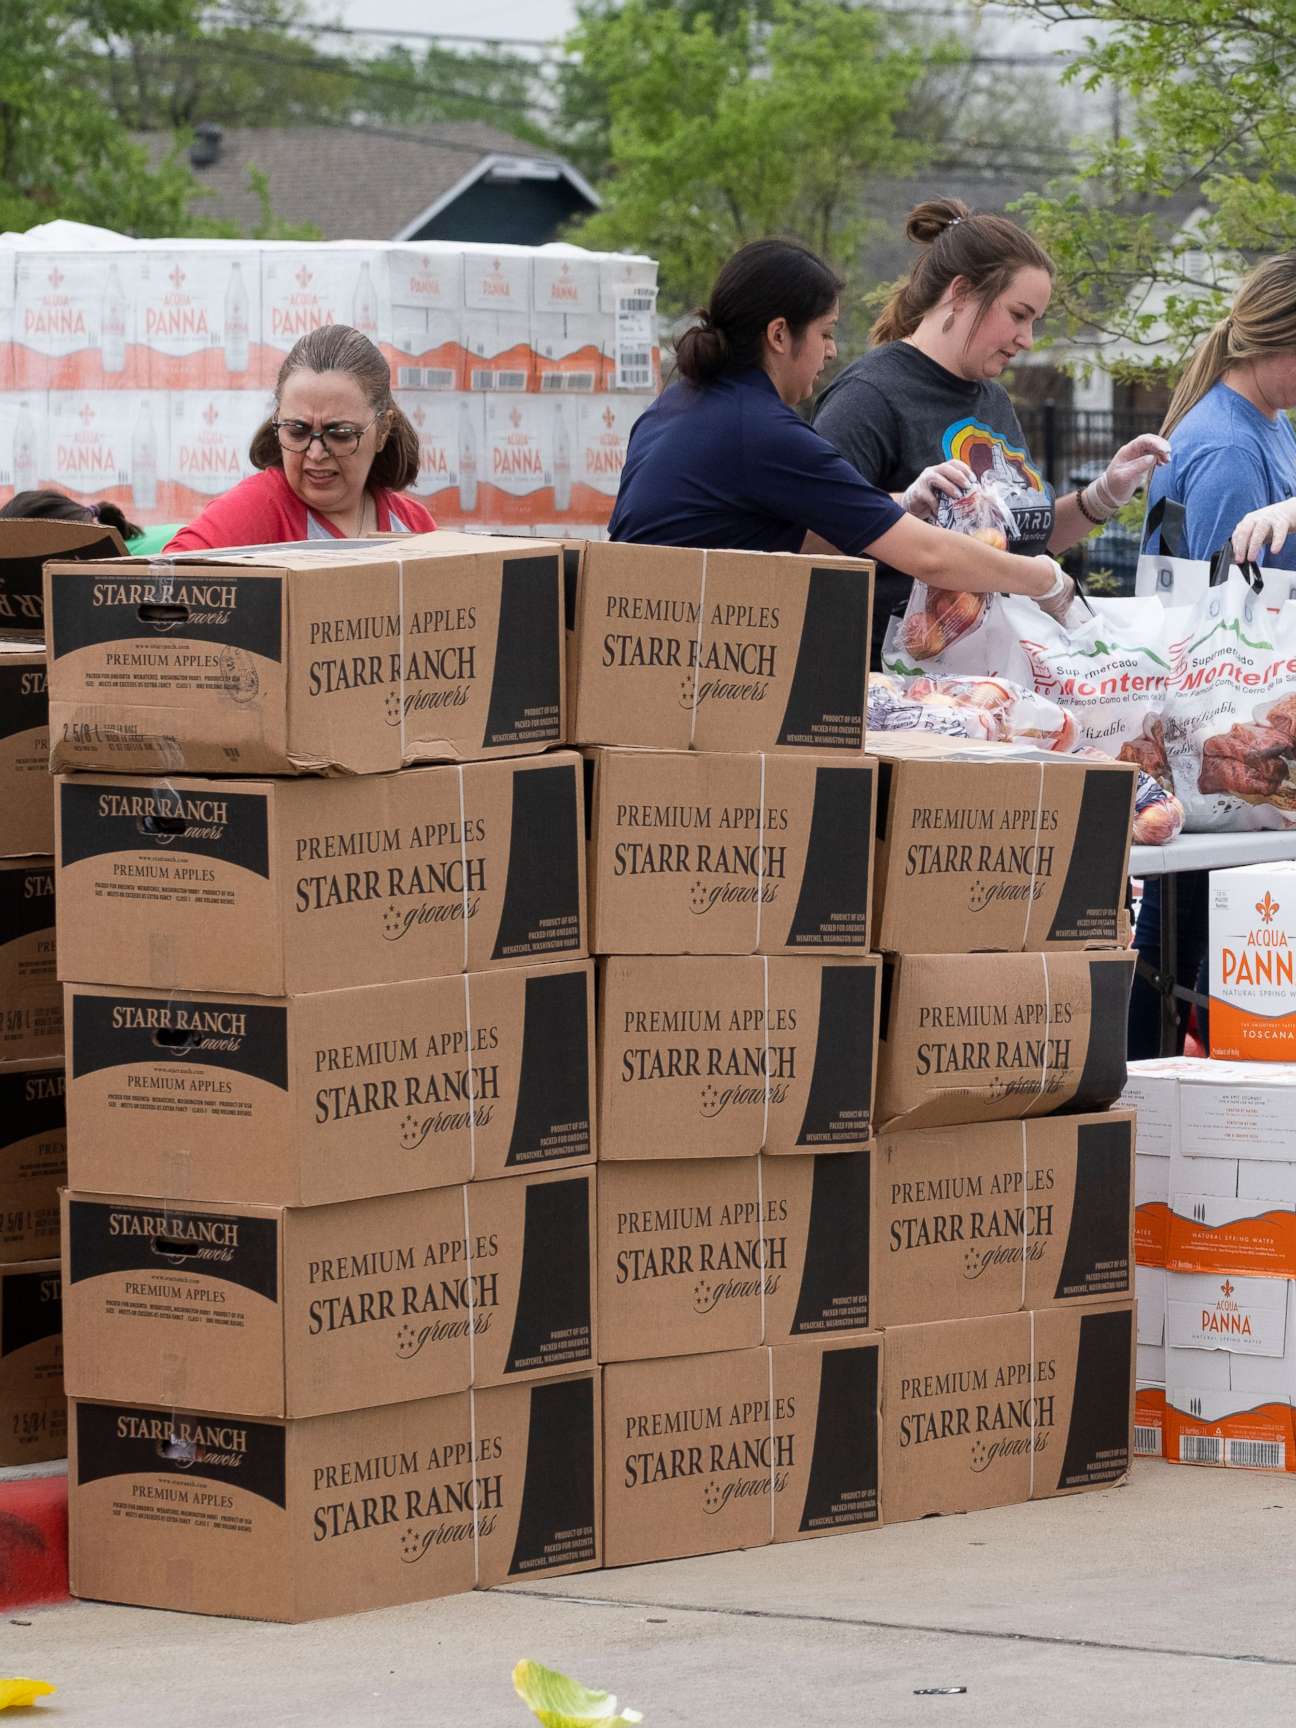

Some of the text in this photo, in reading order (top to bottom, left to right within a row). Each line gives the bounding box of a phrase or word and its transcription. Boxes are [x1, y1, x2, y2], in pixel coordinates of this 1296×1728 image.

[24, 308, 86, 334] PANNA
[145, 308, 208, 335] PANNA
[57, 448, 116, 472] PANNA
[179, 448, 240, 473] PANNA
[494, 448, 543, 473] PANNA
[586, 448, 625, 474] PANN
[93, 584, 238, 609] STARR RANCH
[606, 596, 780, 629] PREMIUM APPLES
[310, 607, 476, 644] PREMIUM APPLES
[106, 654, 219, 667] PREMIUM APPLES
[309, 646, 476, 696] STARR RANCH
[602, 634, 776, 677] STARR RANCH
[1057, 659, 1138, 679] Suprmercado
[21, 673, 48, 695] STA
[694, 679, 768, 705] growers
[1061, 672, 1170, 696] Monterr
[1242, 686, 1265, 694] Cerro
[1275, 677, 1282, 685] la
[395, 685, 470, 720] growers
[1057, 697, 1068, 705] Tan
[99, 794, 228, 824] STARR RANCH
[616, 804, 788, 830] PREMIUM APPLES
[911, 808, 1059, 831] PREMIUM APPLES
[296, 818, 486, 861] PREMIUM APPLES
[113, 863, 216, 881] PREMIUM APPLES
[614, 842, 787, 879] STARR RANCH
[905, 844, 1055, 877] STARR RANCH
[24, 876, 55, 898] STA
[296, 858, 488, 913] STARR RANCH
[701, 881, 780, 910] growers
[977, 881, 1046, 907] growers
[399, 896, 480, 935] growers
[1247, 929, 1288, 948] ACQUA
[1222, 989, 1256, 998] NATURAL
[1259, 990, 1287, 998] SPRING
[112, 1006, 247, 1036] STARR RANCH
[624, 1008, 797, 1032] PREMIUM APPLES
[919, 1002, 1073, 1028] PREMIUM APPLES
[315, 1026, 499, 1072] PREMIUM APPLES
[1242, 1031, 1295, 1040] TOSCANA
[622, 1046, 797, 1082] STARR RANCH
[916, 1039, 1072, 1076] STARR RANCH
[25, 1076, 66, 1101] STAR
[127, 1075, 232, 1093] PREMIUM APPLES
[316, 1065, 500, 1124] STARR RANCH
[711, 1083, 788, 1112] growers
[414, 1104, 494, 1142] growers
[891, 1168, 1055, 1205] PREMIUM APPLES
[109, 1213, 239, 1247] STARR RANCH
[617, 1199, 788, 1235] PREMIUM APPLES
[889, 1204, 1054, 1253] STARR RANCH
[308, 1234, 498, 1284] PREMIUM APPLES
[616, 1237, 787, 1284] STARR RANCH
[975, 1241, 1047, 1274] growers
[125, 1282, 226, 1303] PREMIUM APPLES
[308, 1272, 500, 1336] STARR RANCH
[705, 1274, 781, 1307] growers
[1216, 1300, 1239, 1312] ACQUA
[411, 1312, 493, 1352] growers
[1202, 1311, 1251, 1335] PANNA
[901, 1359, 1056, 1400] PREMIUM APPLES
[116, 1416, 247, 1452] STARR RANCH
[626, 1396, 796, 1439] PREMIUM APPLES
[899, 1395, 1055, 1449] STARR RANCH
[313, 1436, 503, 1490] PREMIUM APPLES
[624, 1434, 796, 1489] STARR RANCH
[981, 1431, 1049, 1465] growers
[132, 1484, 234, 1509] PREMIUM APPLES
[715, 1471, 790, 1508] growers
[313, 1474, 504, 1542] STARR RANCH
[415, 1514, 497, 1555] growers
